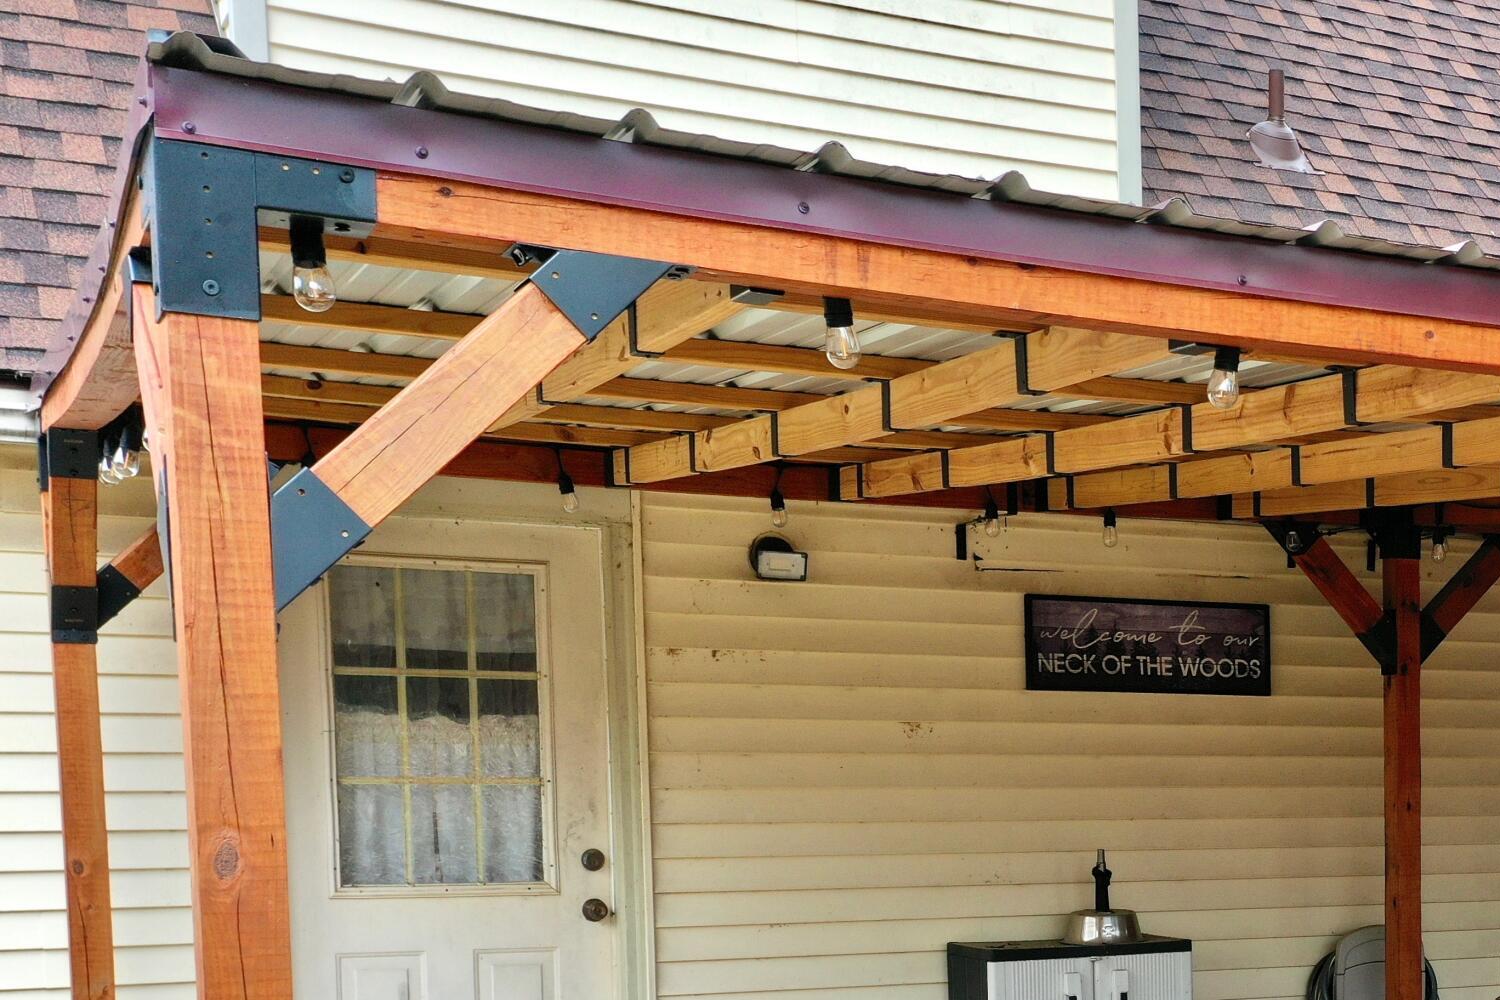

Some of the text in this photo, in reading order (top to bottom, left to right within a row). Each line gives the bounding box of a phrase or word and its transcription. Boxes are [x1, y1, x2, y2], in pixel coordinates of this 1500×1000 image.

[1040, 608, 1259, 649] welcome to our
[1037, 652, 1261, 679] NECK OF THE WOODS
